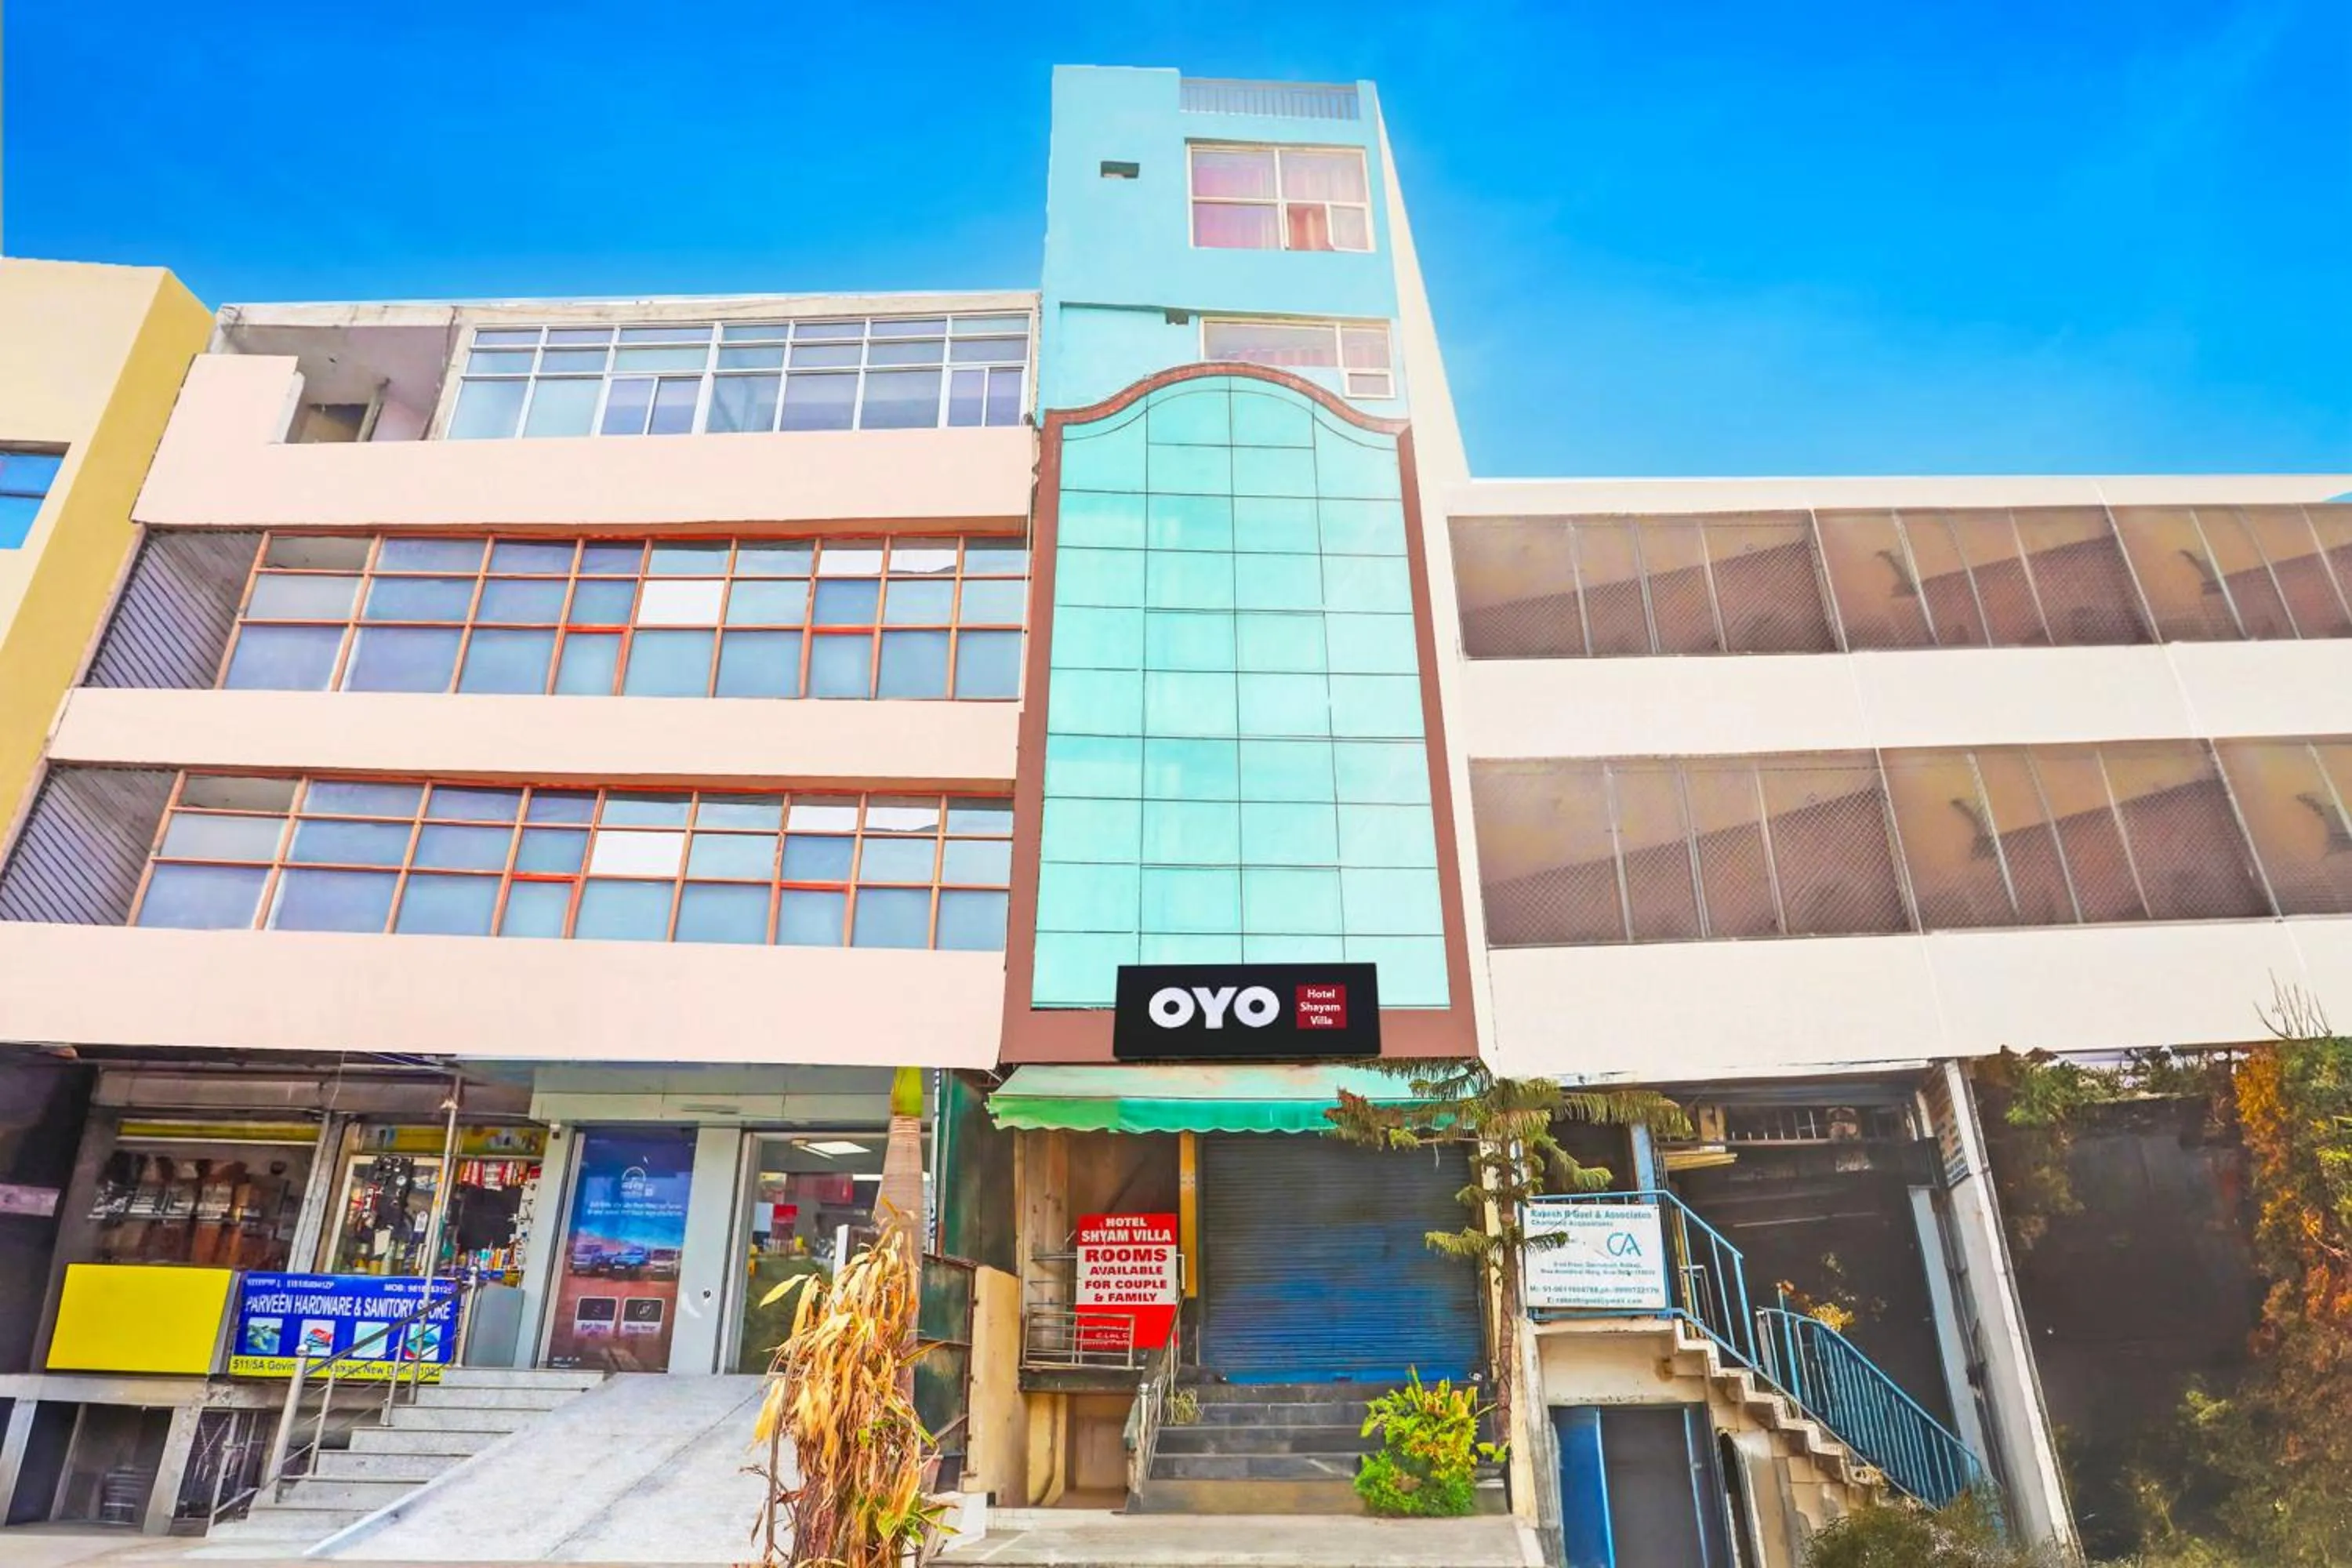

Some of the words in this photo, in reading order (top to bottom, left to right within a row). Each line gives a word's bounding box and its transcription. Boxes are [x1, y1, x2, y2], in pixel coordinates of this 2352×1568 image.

[1307, 988, 1335, 998] Hotel
[1149, 986, 1279, 1029] OYO
[1300, 1001, 1341, 1014] Shayam
[1310, 1015, 1333, 1025] Villa
[1105, 1218, 1147, 1227] HOTEL
[1081, 1229, 1129, 1243] SHYAM
[1132, 1229, 1172, 1242] VILLA
[1084, 1248, 1167, 1263] ROOMS
[1089, 1266, 1163, 1276] AVAILABLE
[1084, 1280, 1111, 1290] FOR
[1115, 1279, 1167, 1290] COUPLE
[1094, 1294, 1103, 1302] &
[1108, 1293, 1158, 1302] FAMILY
[245, 1294, 293, 1314] PARVEEN
[293, 1294, 354, 1316] HARDWARE
[354, 1295, 361, 1317] &
[363, 1296, 416, 1318] SANITORY
